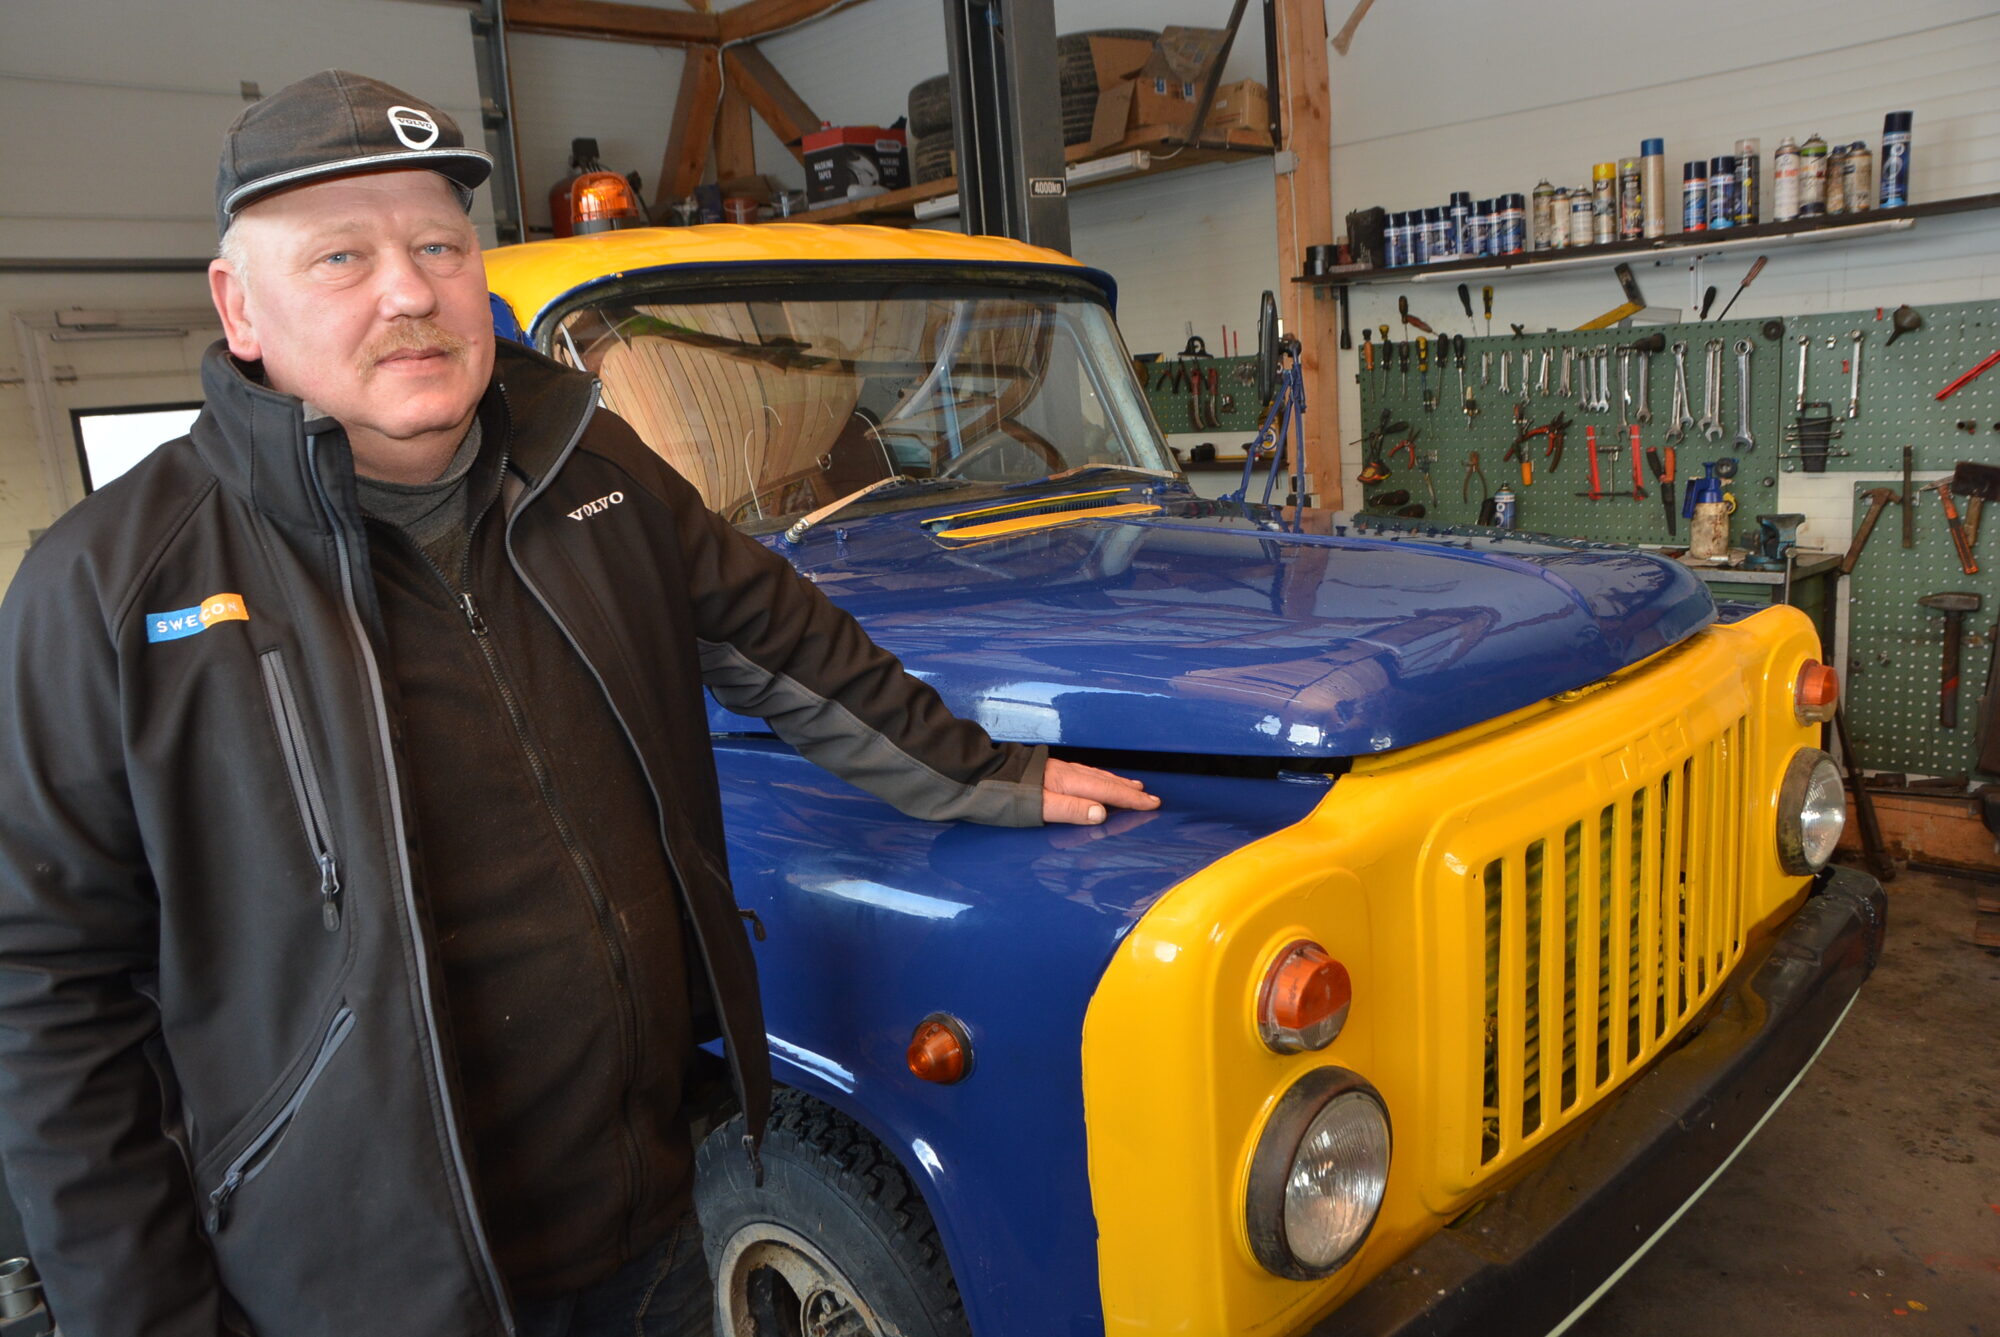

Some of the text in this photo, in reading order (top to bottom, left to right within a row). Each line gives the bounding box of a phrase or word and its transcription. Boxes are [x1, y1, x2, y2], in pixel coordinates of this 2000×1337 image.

[397, 118, 432, 130] VOLVO
[567, 491, 624, 521] VOLVO
[156, 601, 239, 633] SWECON
